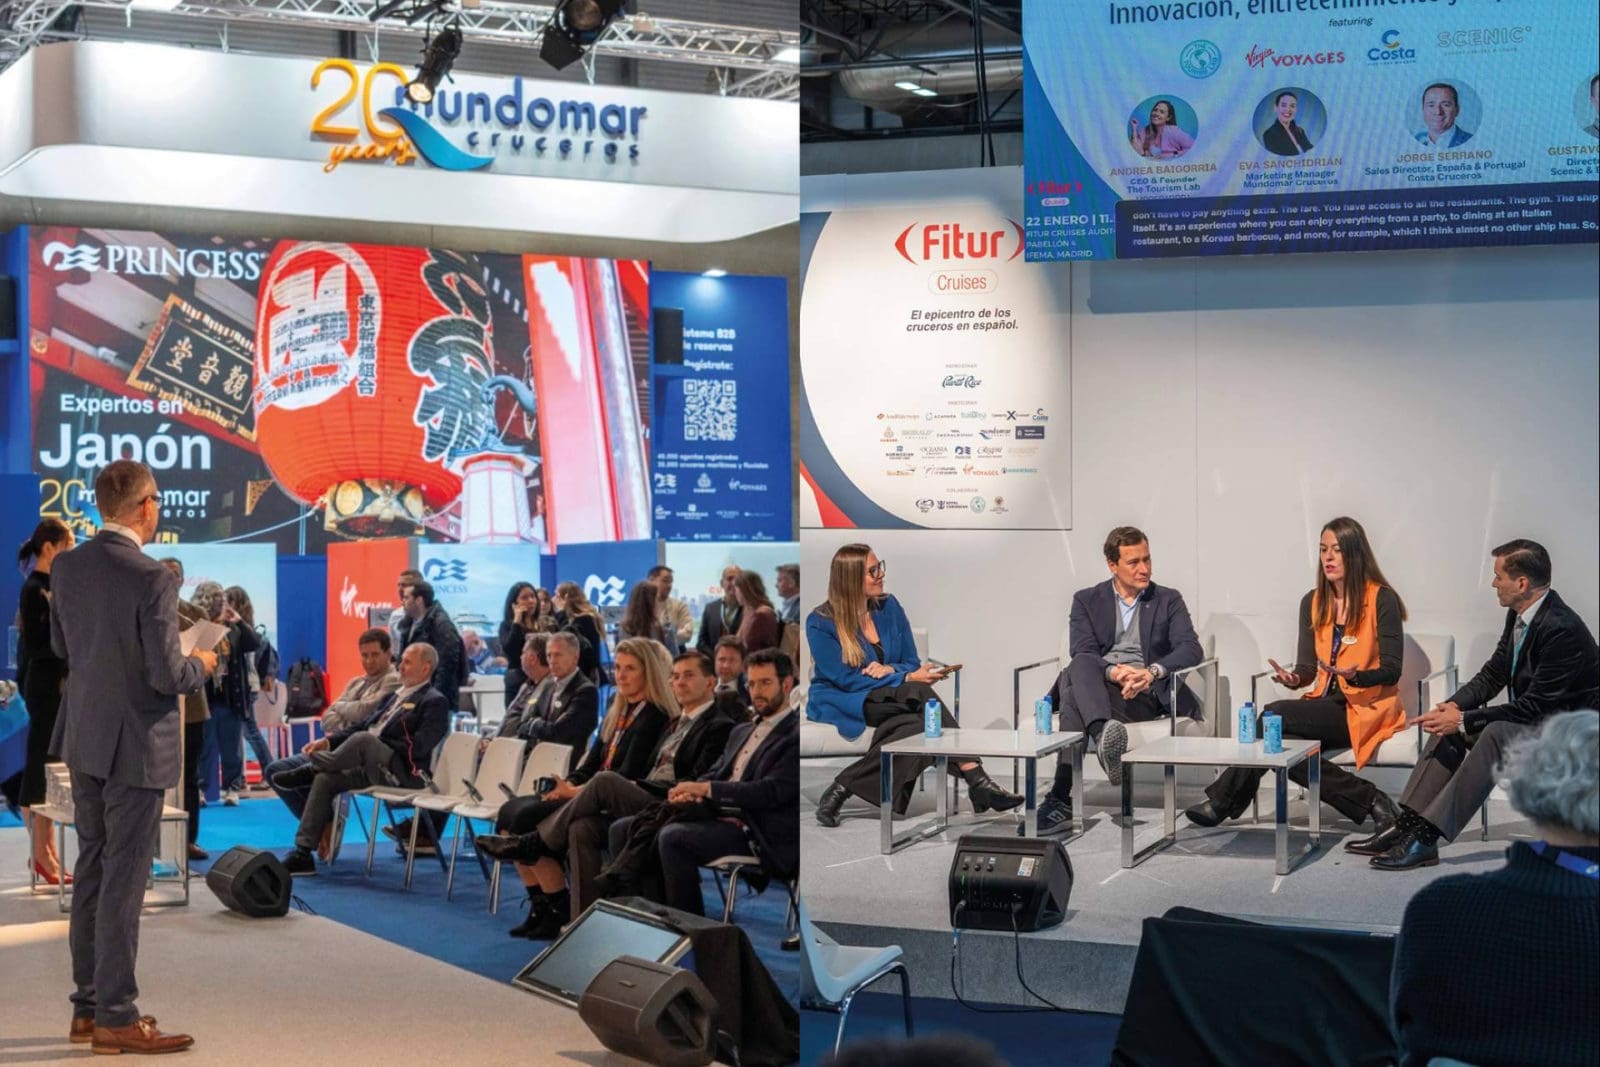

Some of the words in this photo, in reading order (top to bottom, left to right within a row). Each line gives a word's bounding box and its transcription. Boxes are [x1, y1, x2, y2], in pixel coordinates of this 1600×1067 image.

[1328, 17, 1374, 28] featuring
[1271, 51, 1345, 67] VOYAGES
[1367, 48, 1416, 62] Costa
[467, 129, 639, 160] cruceros
[1397, 153, 1435, 163] JORGE
[1437, 150, 1494, 161] SERRANO
[1110, 166, 1154, 177] ANDREA
[1156, 163, 1217, 174] BAIGORRIA
[1239, 161, 1260, 171] EVA
[1365, 167, 1390, 176] Sales
[1436, 162, 1472, 173] España
[1474, 162, 1482, 170] &
[1483, 160, 1527, 171] Portugal
[1550, 167, 1583, 176] Scenic
[1586, 167, 1593, 175] &
[1160, 176, 1197, 184] Founder
[1246, 171, 1292, 181] Marketing
[1295, 169, 1336, 179] Manager
[1408, 174, 1435, 182] Costa
[1437, 172, 1482, 181] Cruceros
[1146, 184, 1181, 193] Tourism
[1184, 183, 1201, 191] Lab
[1243, 179, 1292, 188] Mundomar
[1192, 210, 1208, 219] pay
[1323, 204, 1341, 212] You
[1026, 216, 1040, 226] 22
[1044, 214, 1089, 226] ENERO
[1174, 223, 1185, 231] an
[1188, 221, 1237, 233] experience
[1239, 220, 1267, 228] where
[1269, 220, 1286, 229] you
[1308, 217, 1333, 227] enjoy
[1335, 215, 1385, 226] everything
[1388, 214, 1410, 222] from
[1420, 213, 1448, 224] party,
[1450, 212, 1460, 220] to
[1462, 211, 1493, 221] dining
[1495, 210, 1505, 218] at
[1522, 209, 1552, 217] Italian
[1026, 230, 1050, 238] FITUR
[1051, 228, 1086, 237] CRUISES
[1088, 227, 1116, 235] AUDIT
[1133, 235, 1181, 245] restaurant,
[1183, 235, 1193, 243] to
[1202, 234, 1235, 243] Korean
[1236, 232, 1282, 242] barbecue,
[1284, 231, 1301, 240] and
[1303, 232, 1330, 240] more,
[1332, 230, 1346, 238] for
[1348, 228, 1390, 239] example,
[1393, 226, 1421, 236] which
[1429, 225, 1454, 234] think
[1455, 224, 1489, 233] almost
[1506, 223, 1532, 232] other
[1534, 222, 1556, 232] ship
[1558, 221, 1580, 230] has.
[1056, 249, 1093, 258] MADRID
[105, 244, 261, 281] PRINCESS
[937, 274, 987, 291] Cruises
[911, 309, 922, 320] El
[924, 308, 975, 321] epicentro
[978, 308, 991, 319] de
[994, 307, 1011, 318] los
[906, 320, 953, 332] cruceros
[956, 322, 970, 331] en
[972, 319, 1019, 333] español.
[694, 342, 734, 352] reservas
[60, 393, 153, 416] Expertos
[158, 397, 184, 414] en
